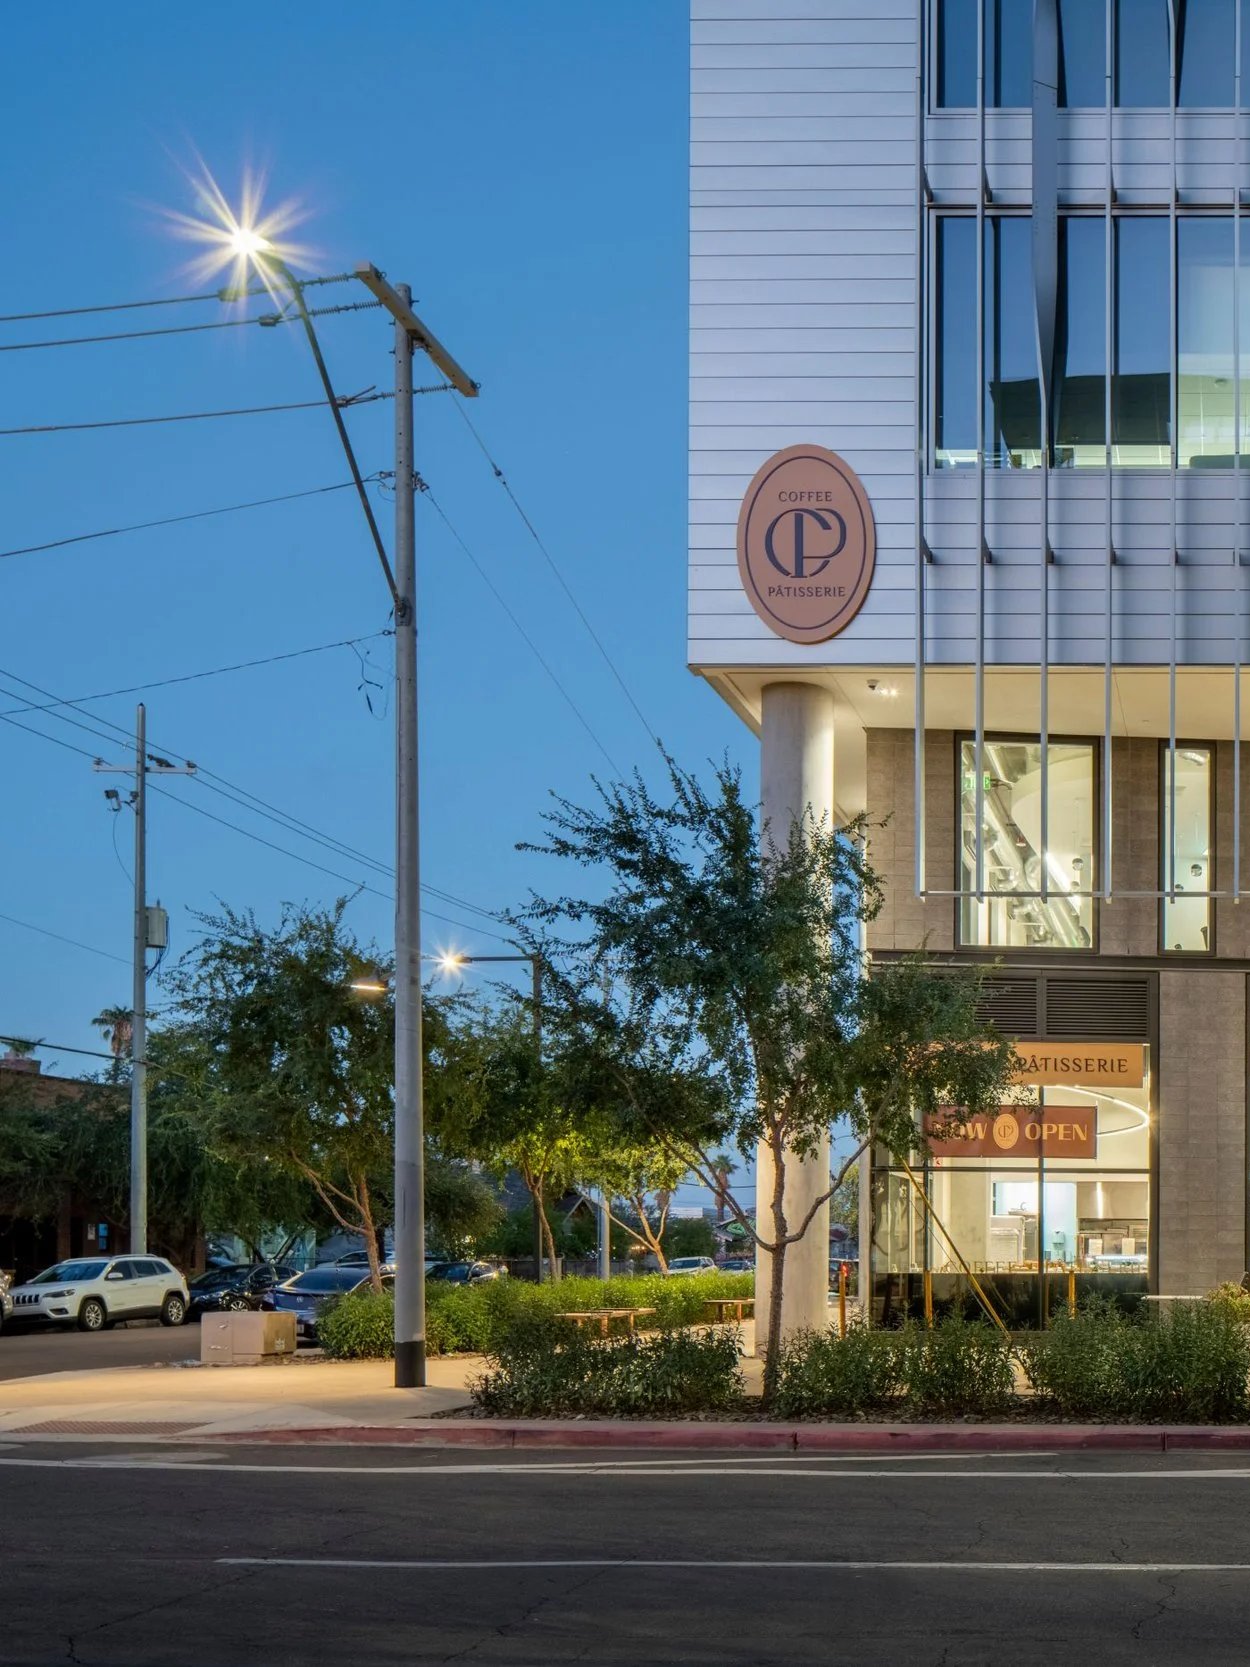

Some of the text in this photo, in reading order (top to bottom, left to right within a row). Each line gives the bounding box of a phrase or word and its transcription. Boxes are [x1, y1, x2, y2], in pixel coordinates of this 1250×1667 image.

[778, 491, 833, 502] COFFEE
[768, 585, 846, 597] PÂTISSERIE
[1025, 1123, 1088, 1141] OPEN
